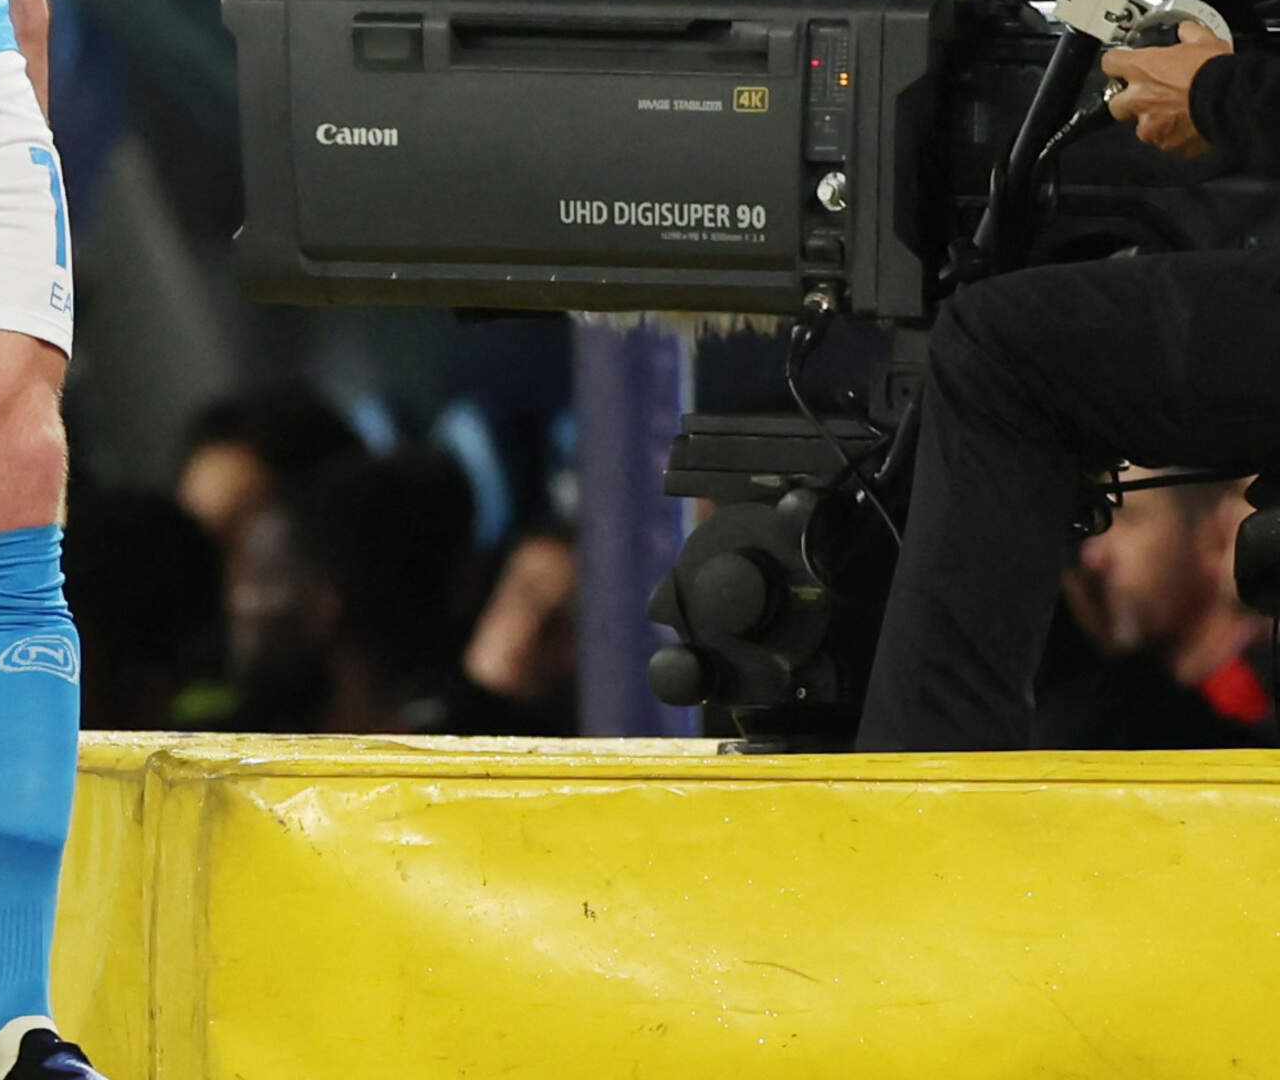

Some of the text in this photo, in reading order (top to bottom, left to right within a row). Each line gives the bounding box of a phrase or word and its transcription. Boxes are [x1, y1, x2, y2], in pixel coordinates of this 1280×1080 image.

[738, 90, 764, 109] 4K
[315, 123, 399, 146] Canon
[559, 199, 766, 229] UHD DIGISUPER 90
